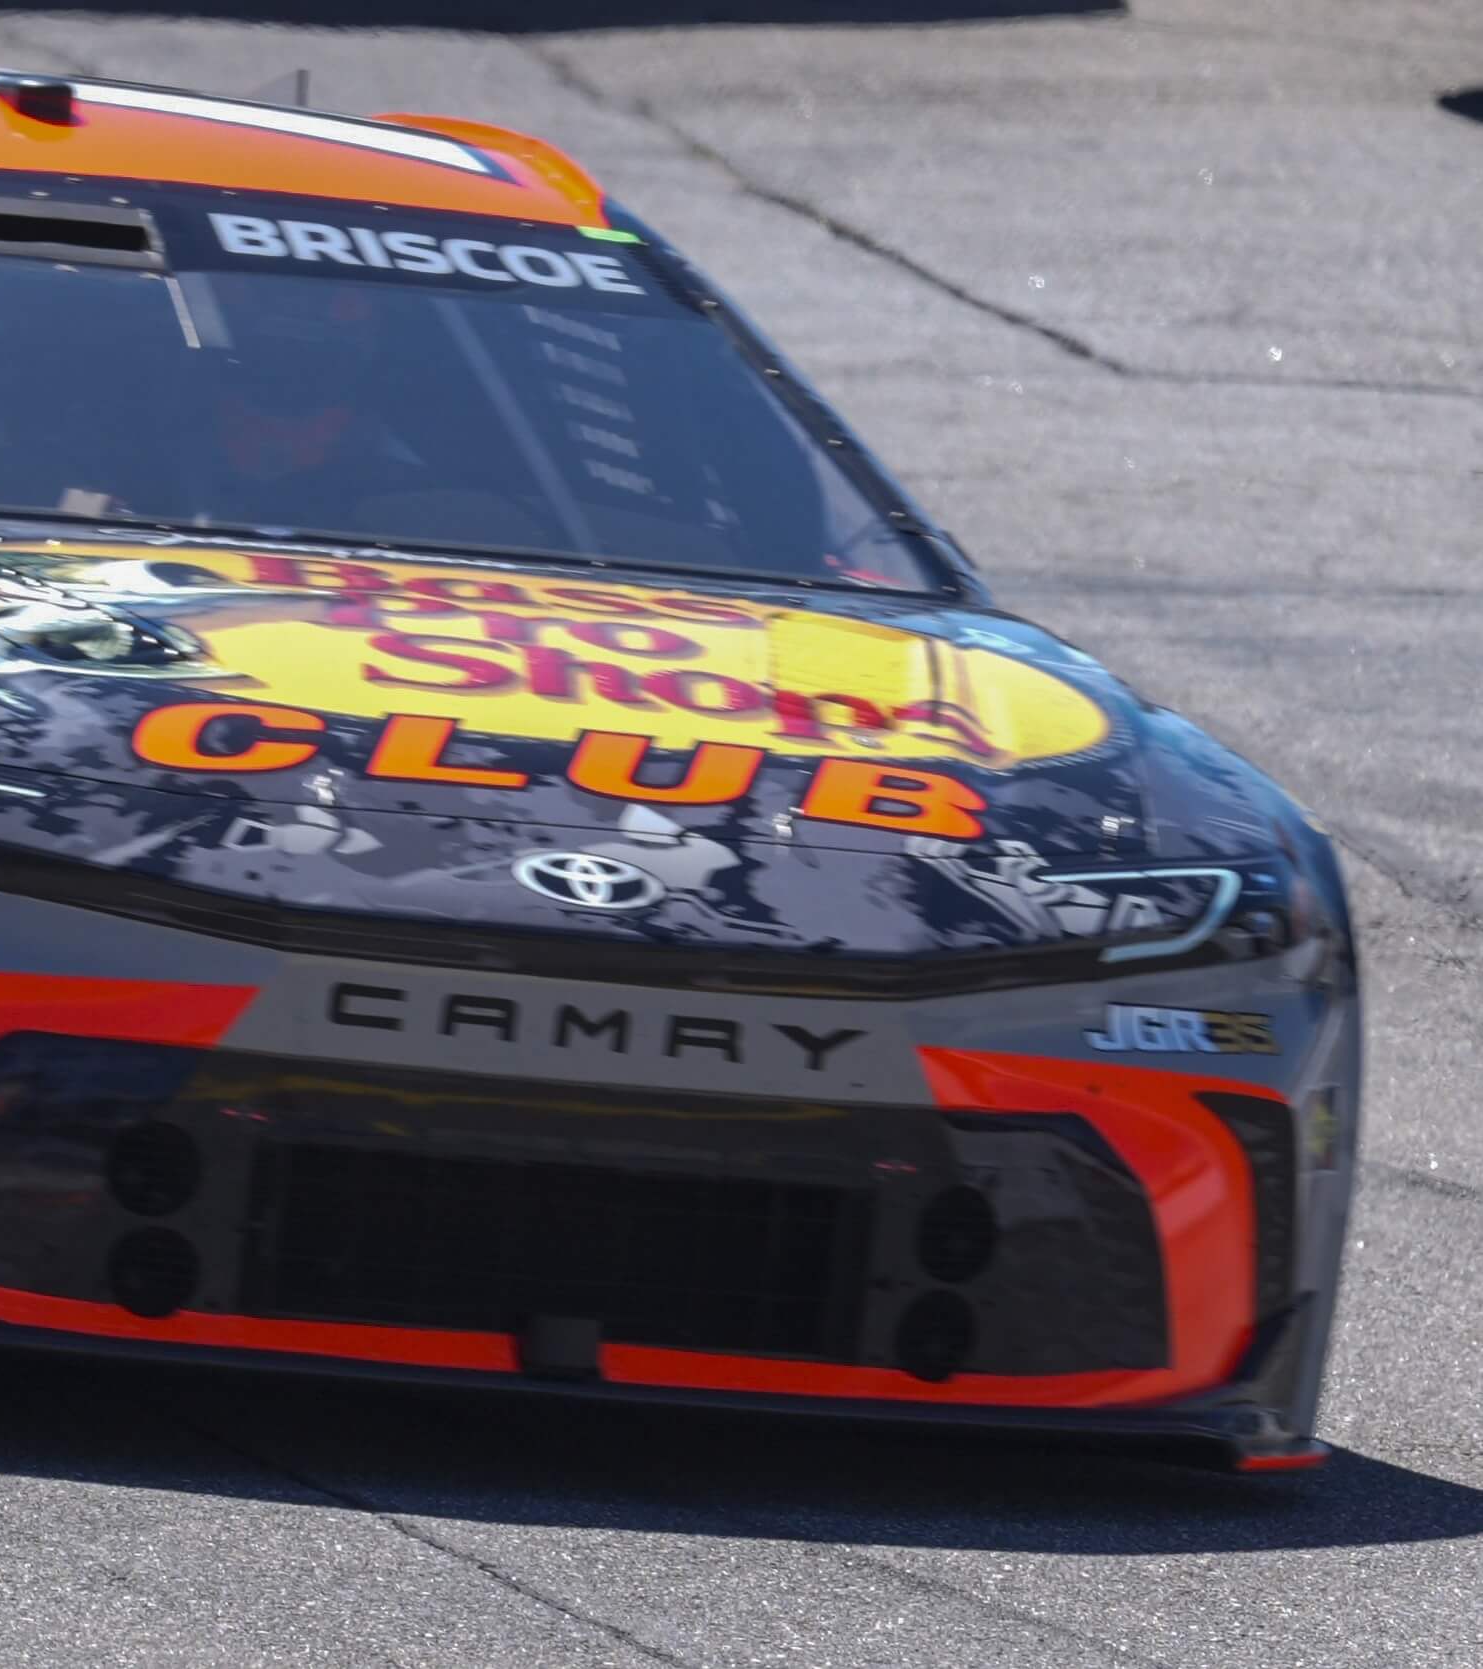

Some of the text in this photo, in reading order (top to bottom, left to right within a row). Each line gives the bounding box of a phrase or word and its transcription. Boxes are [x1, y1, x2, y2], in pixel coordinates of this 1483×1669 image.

[206, 211, 647, 296] BRISCOE
[130, 700, 989, 842] CLUB
[328, 980, 872, 1071] CAMRY
